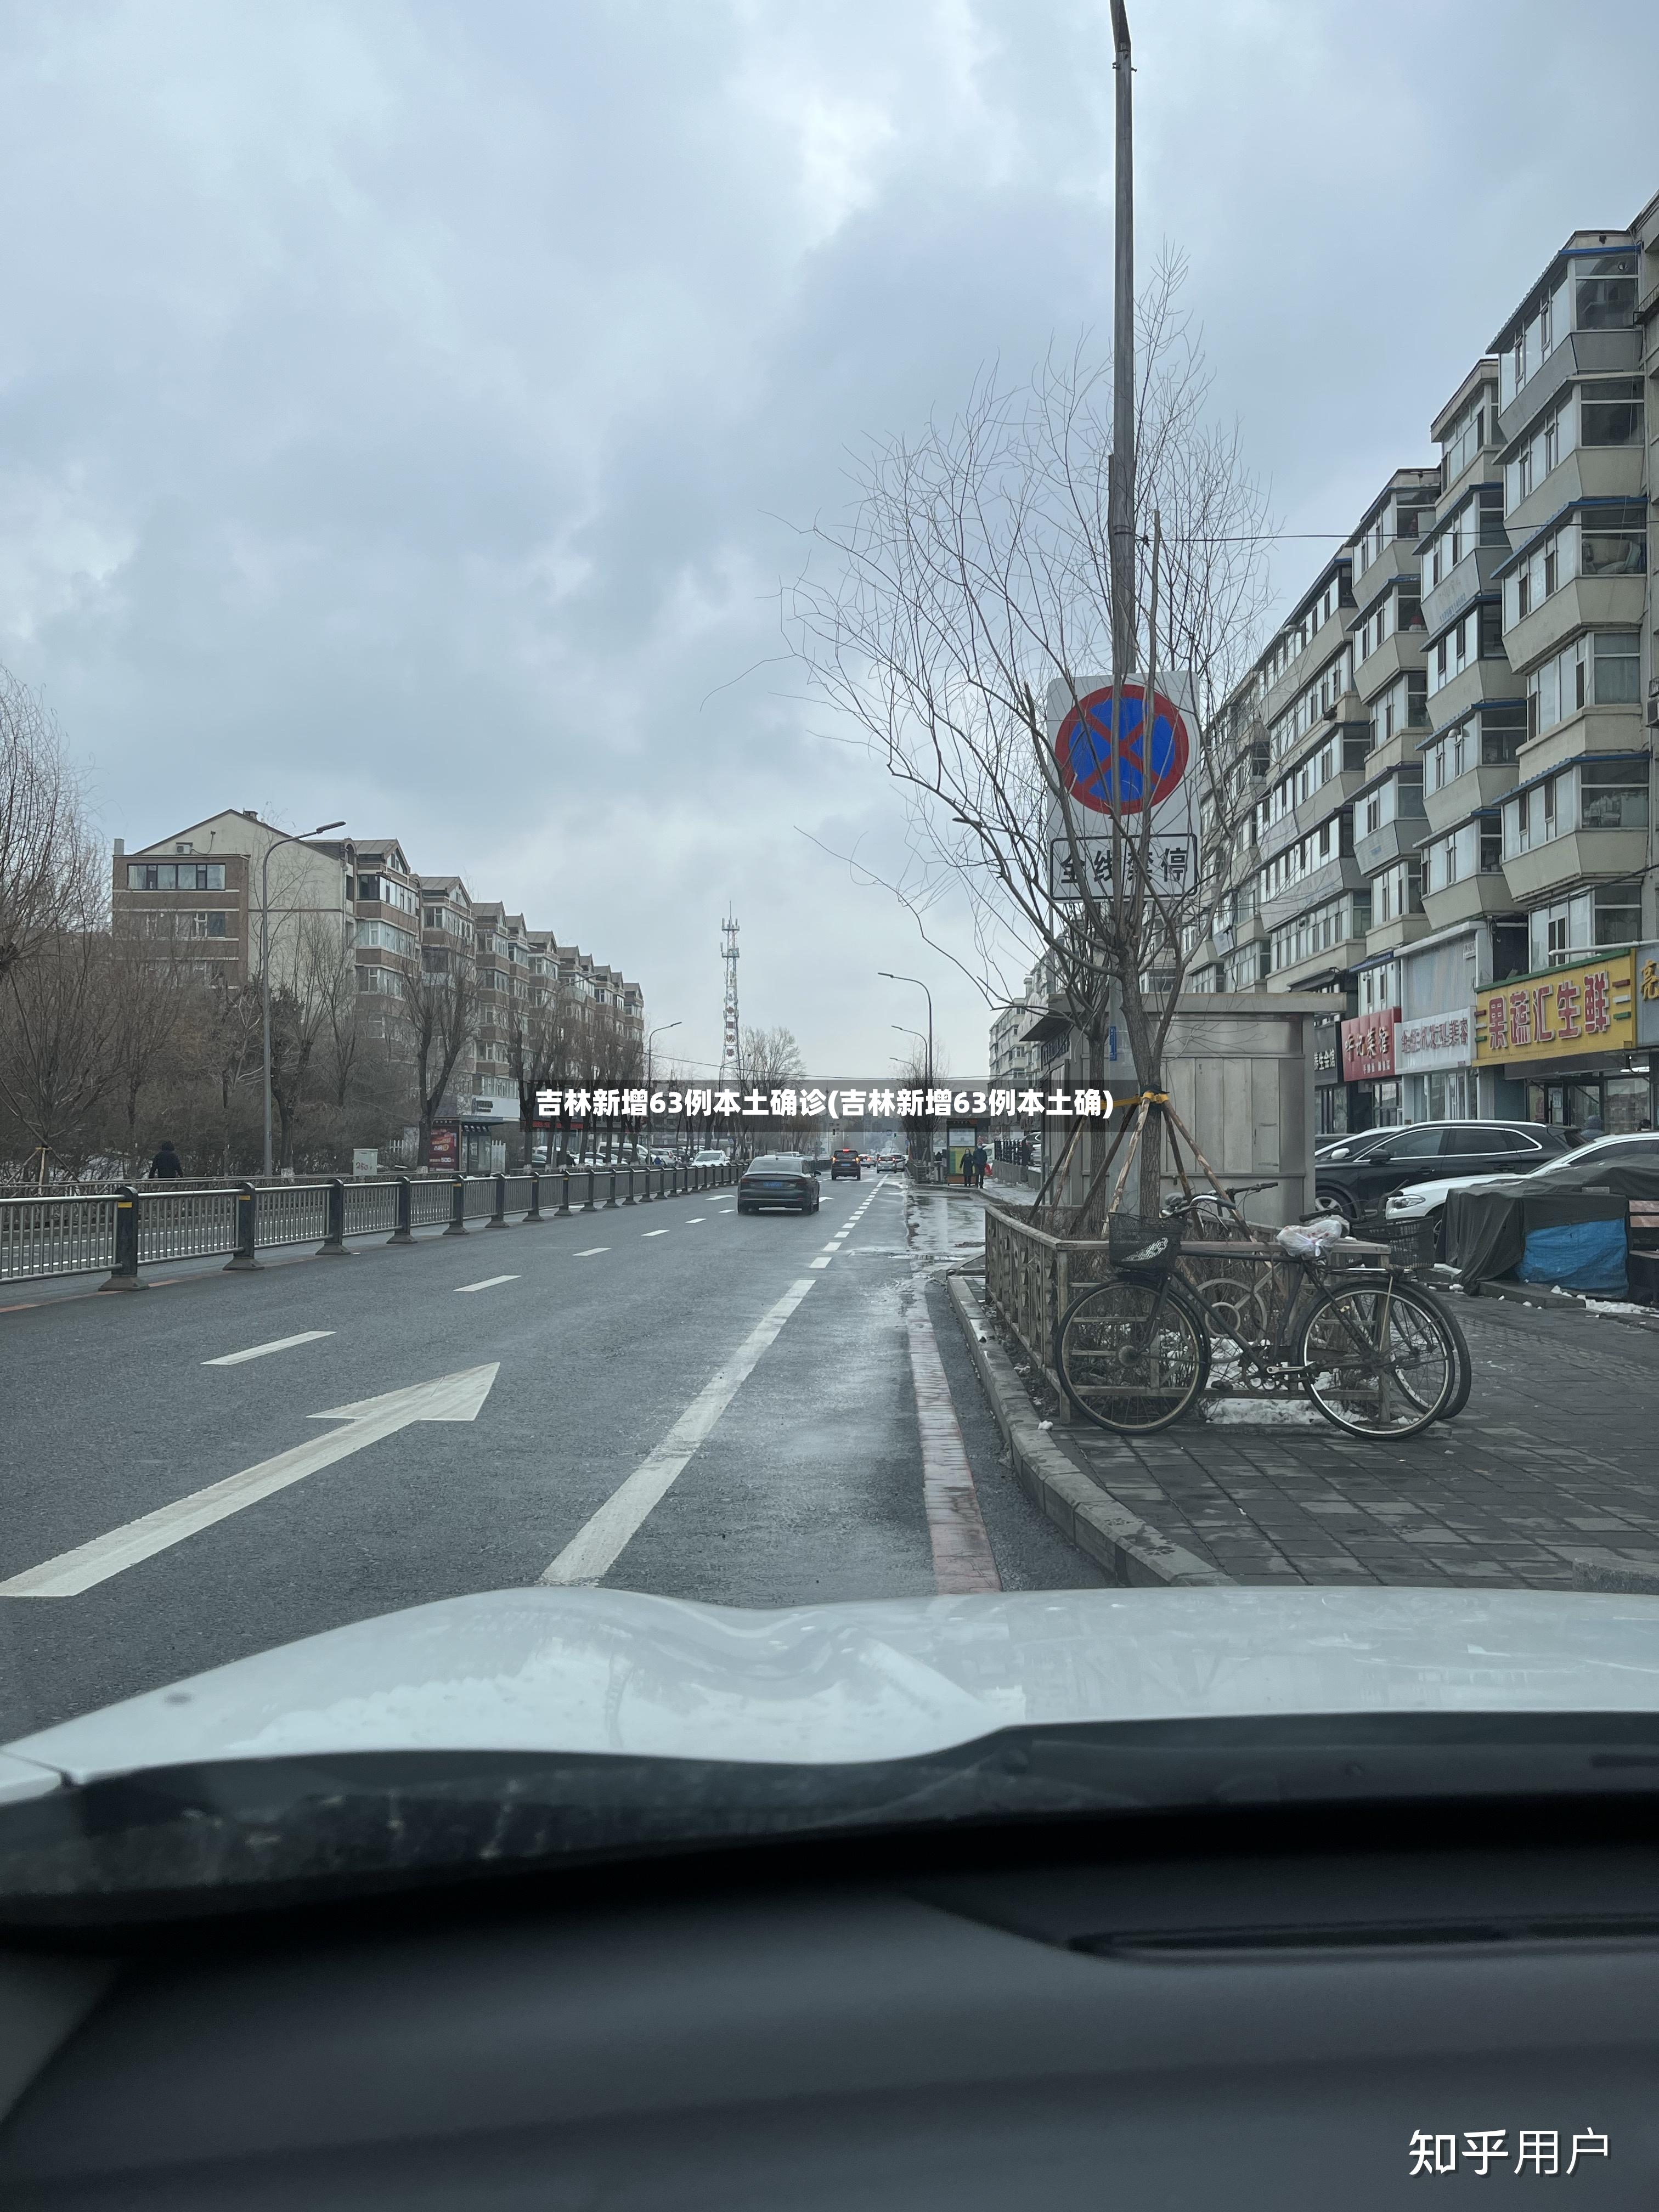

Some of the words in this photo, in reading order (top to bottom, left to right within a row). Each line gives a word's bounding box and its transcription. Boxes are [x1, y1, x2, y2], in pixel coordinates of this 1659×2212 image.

[1060, 847, 1188, 885] 全线禁停
[1488, 971, 1610, 1050] 果蔬汇生鲜
